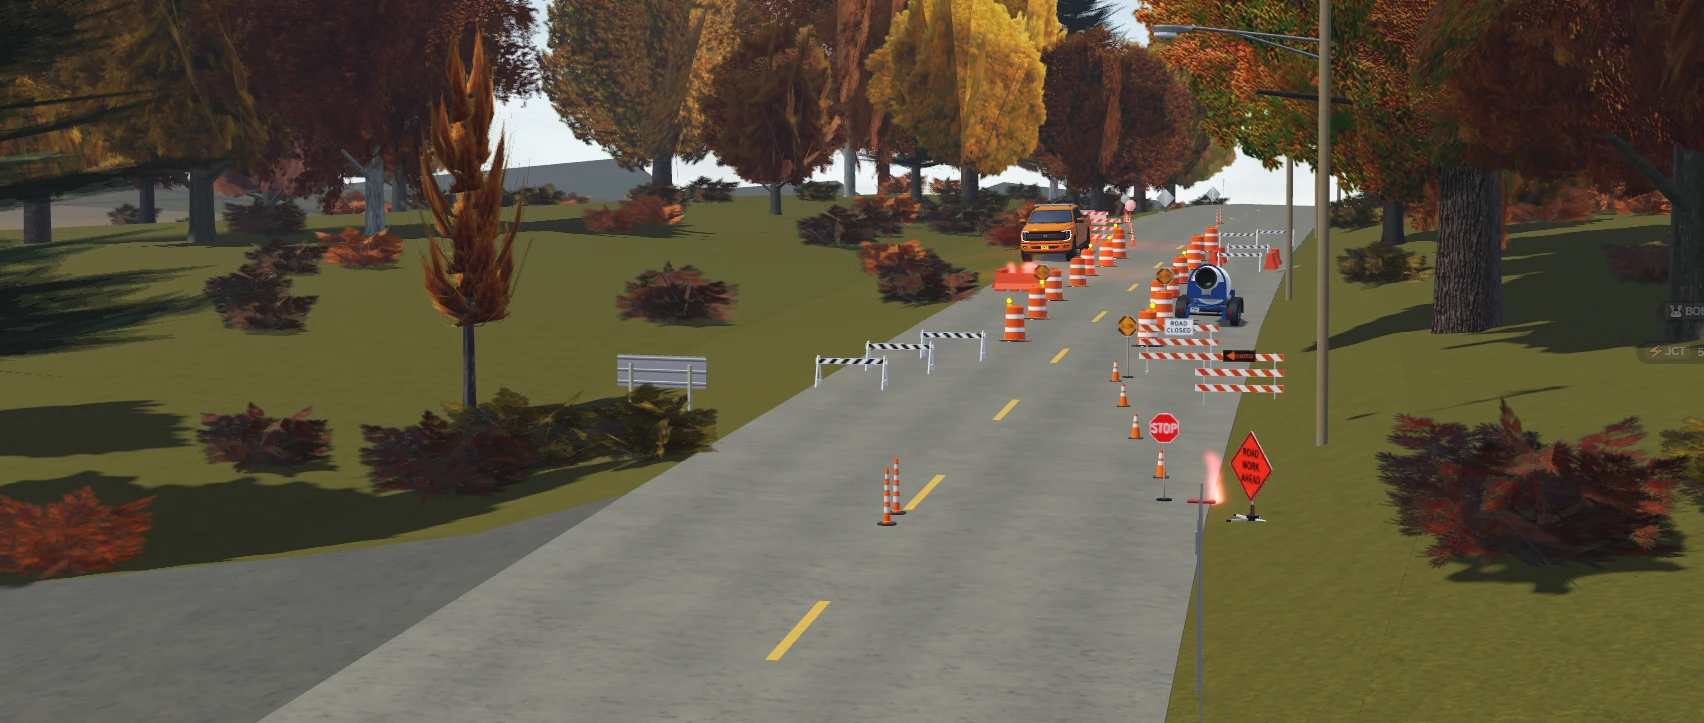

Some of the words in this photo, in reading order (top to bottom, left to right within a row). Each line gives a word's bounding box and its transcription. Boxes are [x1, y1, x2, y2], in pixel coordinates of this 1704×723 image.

[1151, 422, 1178, 434] STOP
[1242, 447, 1259, 459] ROAD
[1242, 460, 1260, 472] WORK
[1241, 474, 1261, 485] AHEAD
